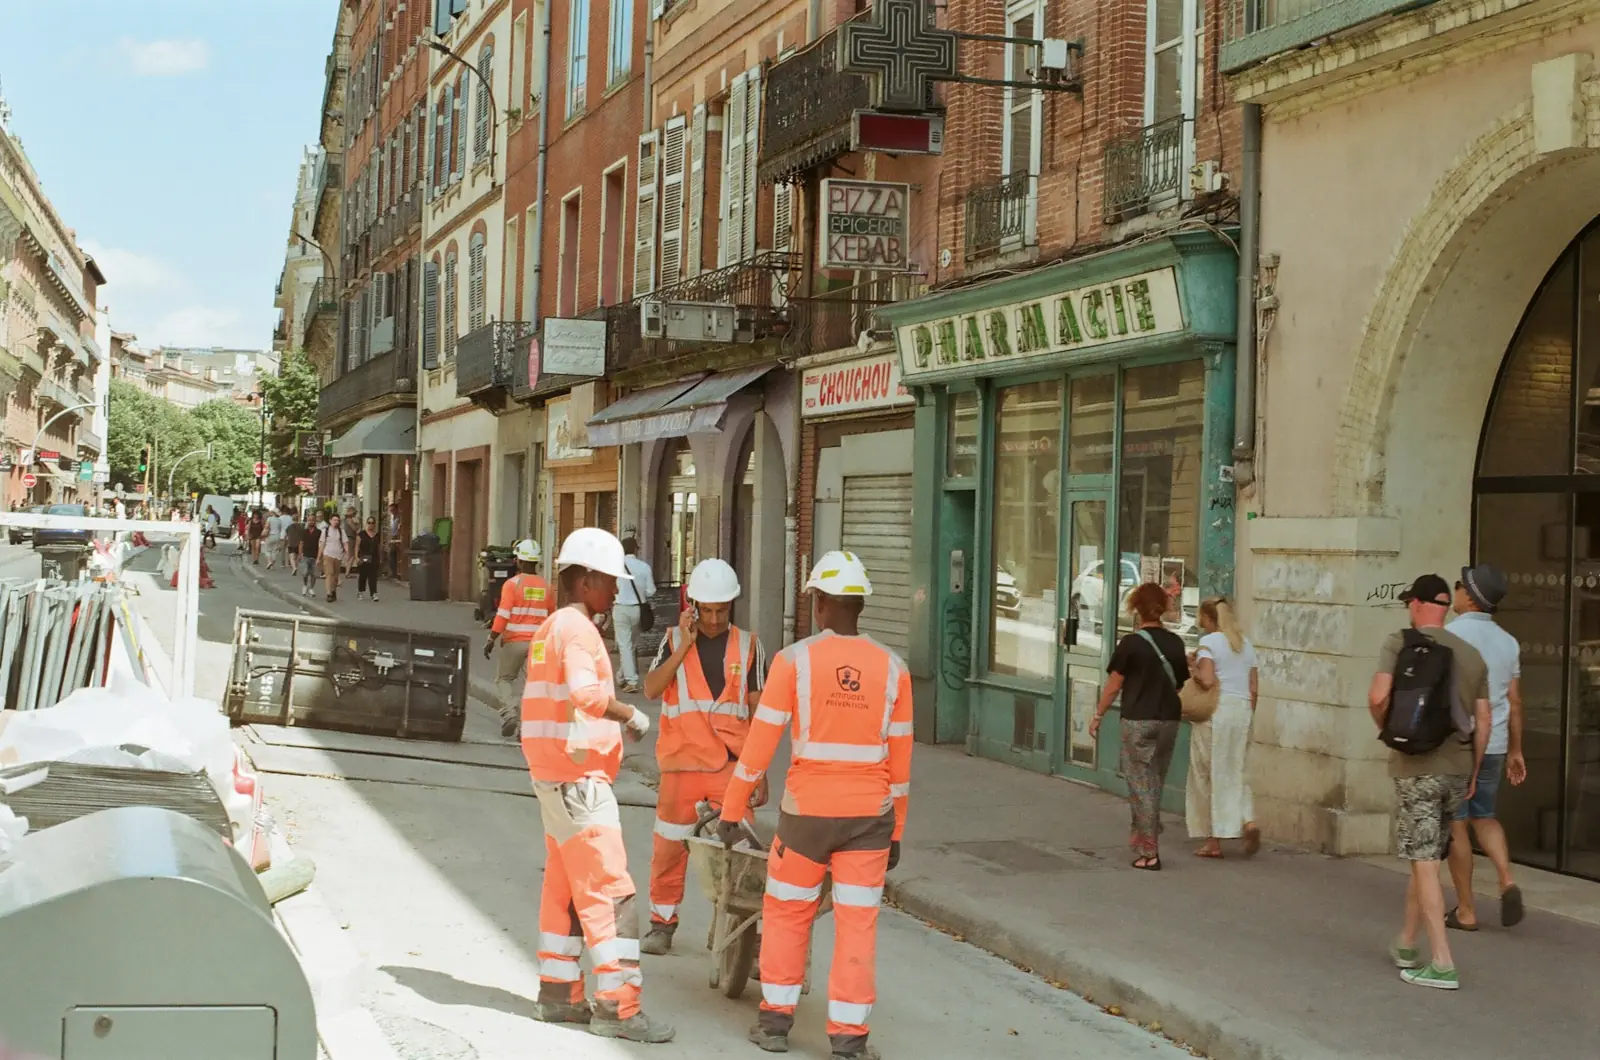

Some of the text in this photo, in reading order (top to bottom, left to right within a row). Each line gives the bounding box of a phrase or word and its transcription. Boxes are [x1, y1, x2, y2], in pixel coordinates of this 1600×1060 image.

[829, 186, 900, 215] PIZZA
[831, 215, 902, 236] EPICERIE
[829, 235, 901, 264] KEBAB
[910, 279, 1156, 368] PHARMACIE
[819, 362, 891, 407] CHOUCHOU
